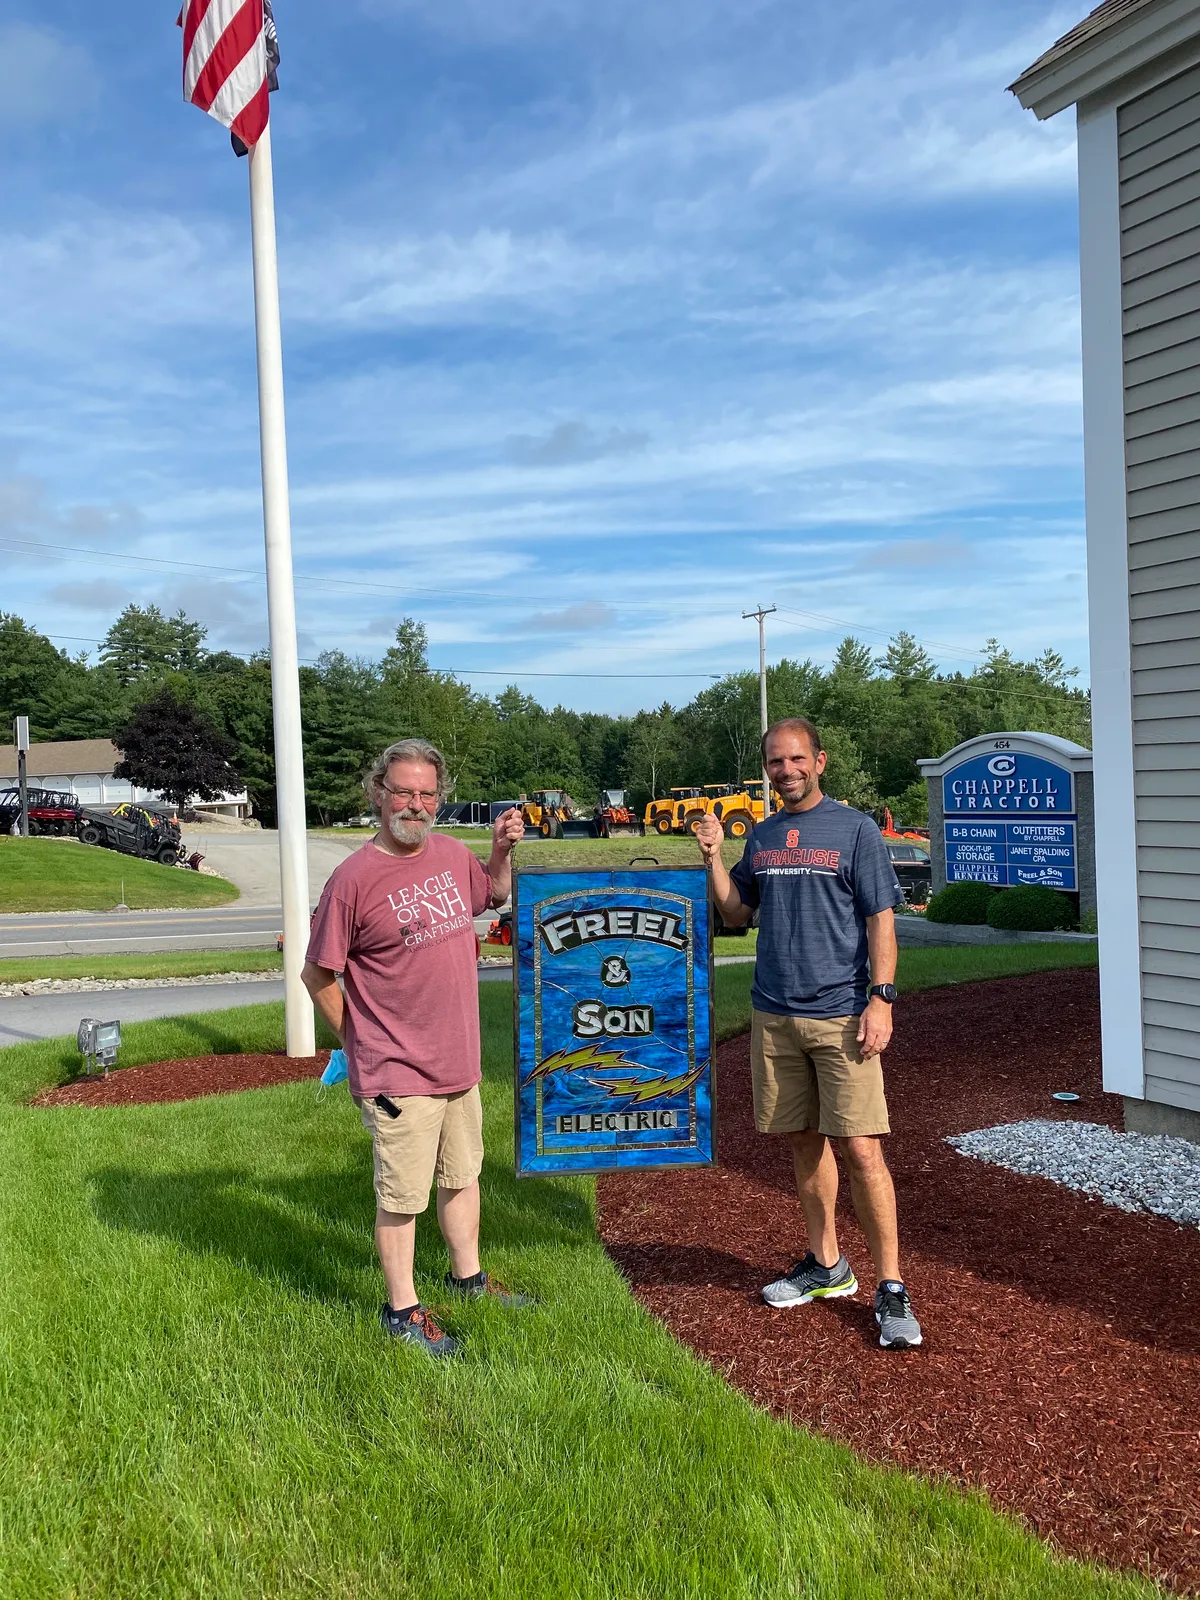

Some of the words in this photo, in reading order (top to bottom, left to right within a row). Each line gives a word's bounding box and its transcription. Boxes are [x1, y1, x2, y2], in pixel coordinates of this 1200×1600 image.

[993, 741, 1010, 749] 454
[952, 778, 1058, 795] CHAPPELL
[955, 796, 1056, 808] TRACTOR
[952, 828, 968, 837] B-B
[970, 828, 997, 838] CHAIN
[1012, 826, 1065, 836] OUTFITTERS
[786, 829, 800, 848] S
[958, 845, 992, 853] LOCK-IT-UP
[1010, 847, 1032, 855] JANET
[1033, 847, 1070, 857] SPALDING
[753, 848, 840, 869] SYRACUSE
[956, 852, 995, 861] STORAGE
[1032, 855, 1046, 863] CPA
[767, 867, 811, 875] UNIVERSITY
[953, 863, 999, 873] CHAPPELL
[1017, 868, 1038, 879] FREEL
[1040, 869, 1046, 877] &
[954, 871, 999, 881] RENTALS
[387, 871, 456, 910] LEAGUE
[397, 904, 421, 923] OF
[420, 888, 466, 924] NH
[405, 913, 470, 946] CRAFTSMEN
[541, 908, 688, 953] FREEL
[603, 957, 630, 985] &
[560, 1110, 676, 1133] ELECTRIC
